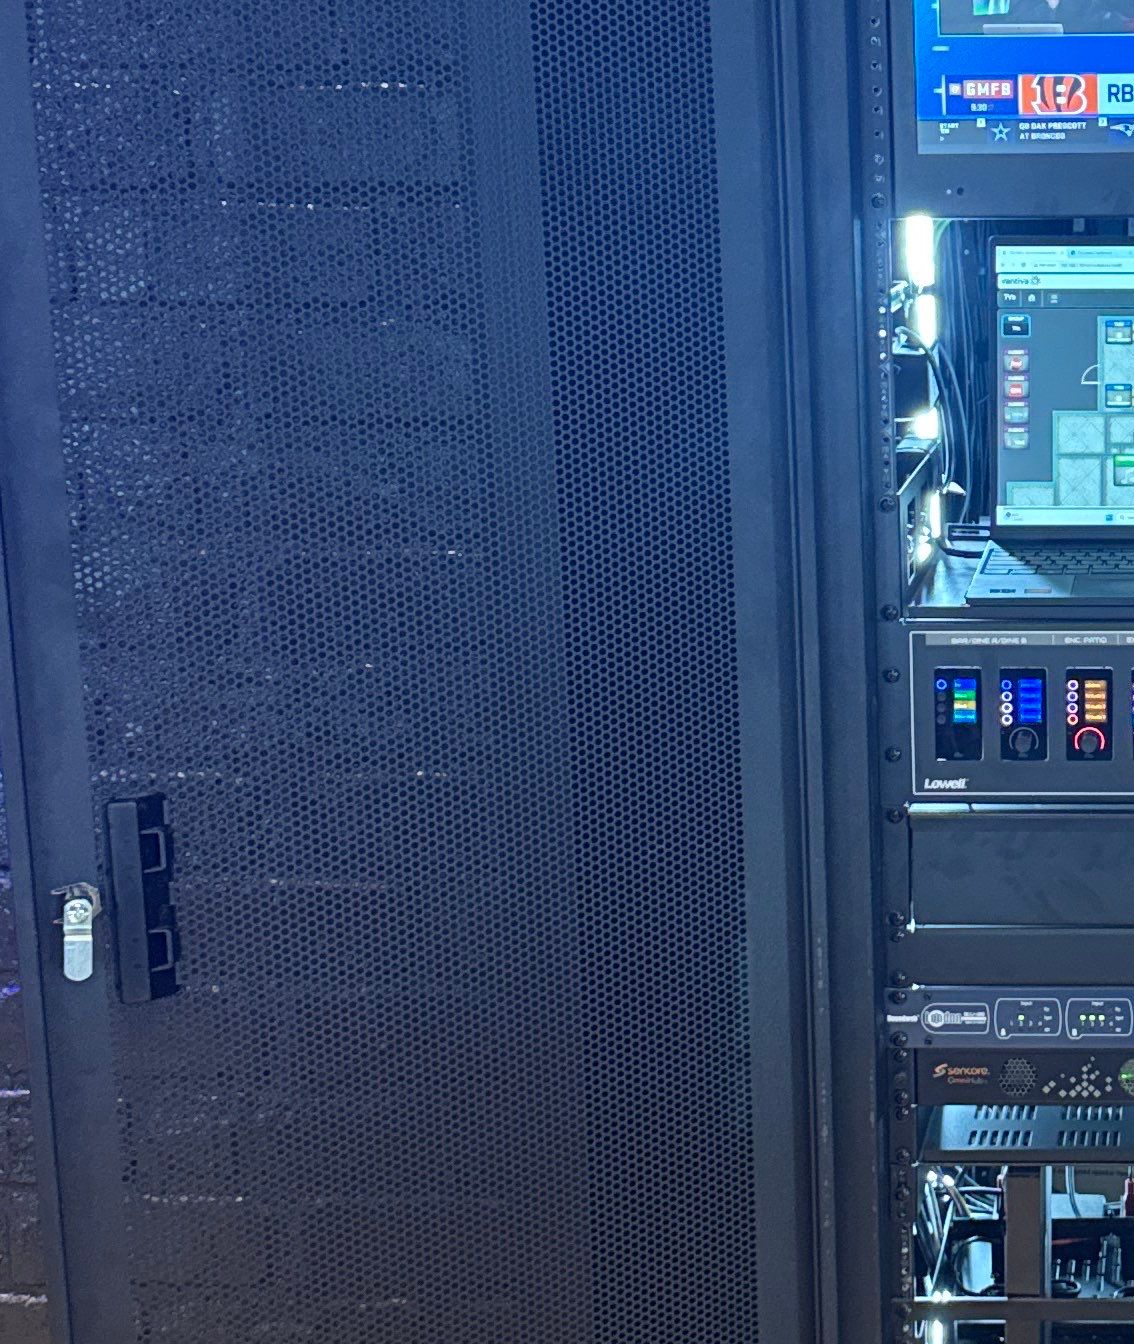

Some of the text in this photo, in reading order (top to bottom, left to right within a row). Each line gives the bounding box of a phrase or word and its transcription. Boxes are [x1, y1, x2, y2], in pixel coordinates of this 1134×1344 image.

[966, 82, 1010, 97] GMFB
[1106, 83, 1134, 103] RB
[924, 777, 968, 789] Lowell
